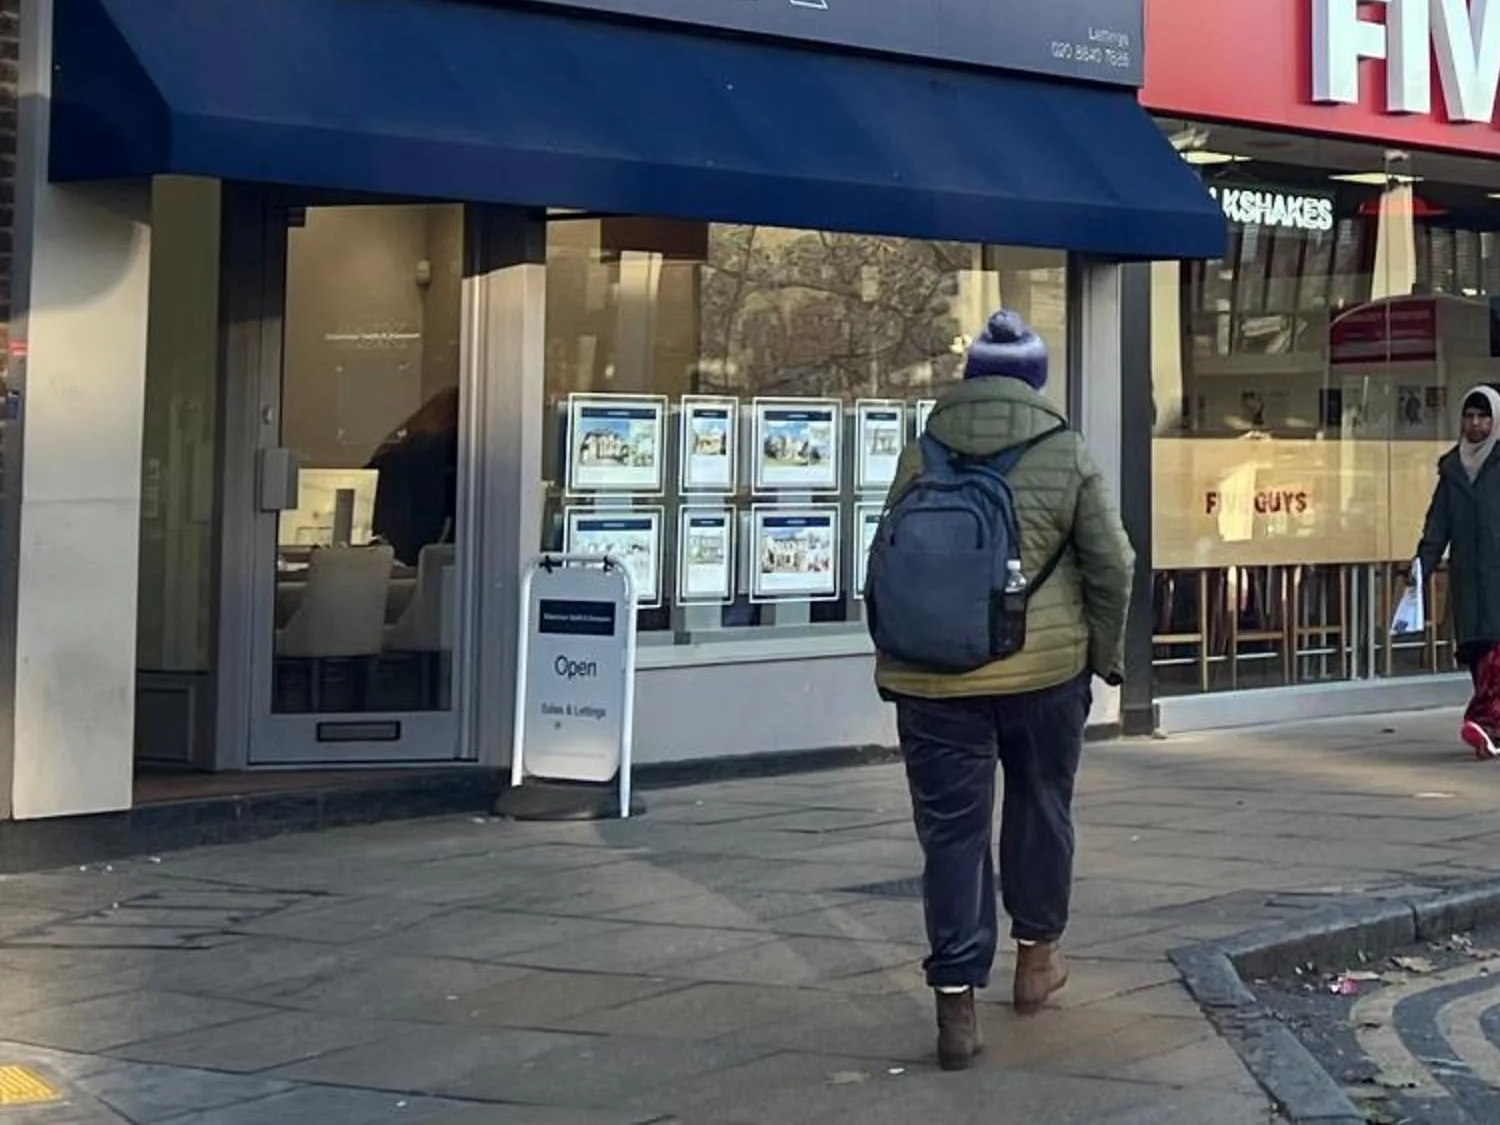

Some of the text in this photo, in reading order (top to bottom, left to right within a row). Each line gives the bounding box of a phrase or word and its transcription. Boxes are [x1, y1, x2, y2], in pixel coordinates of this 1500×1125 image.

[1209, 186, 1333, 230] KSHAKES
[1254, 490, 1308, 514] GUYS
[554, 654, 598, 680] Open
